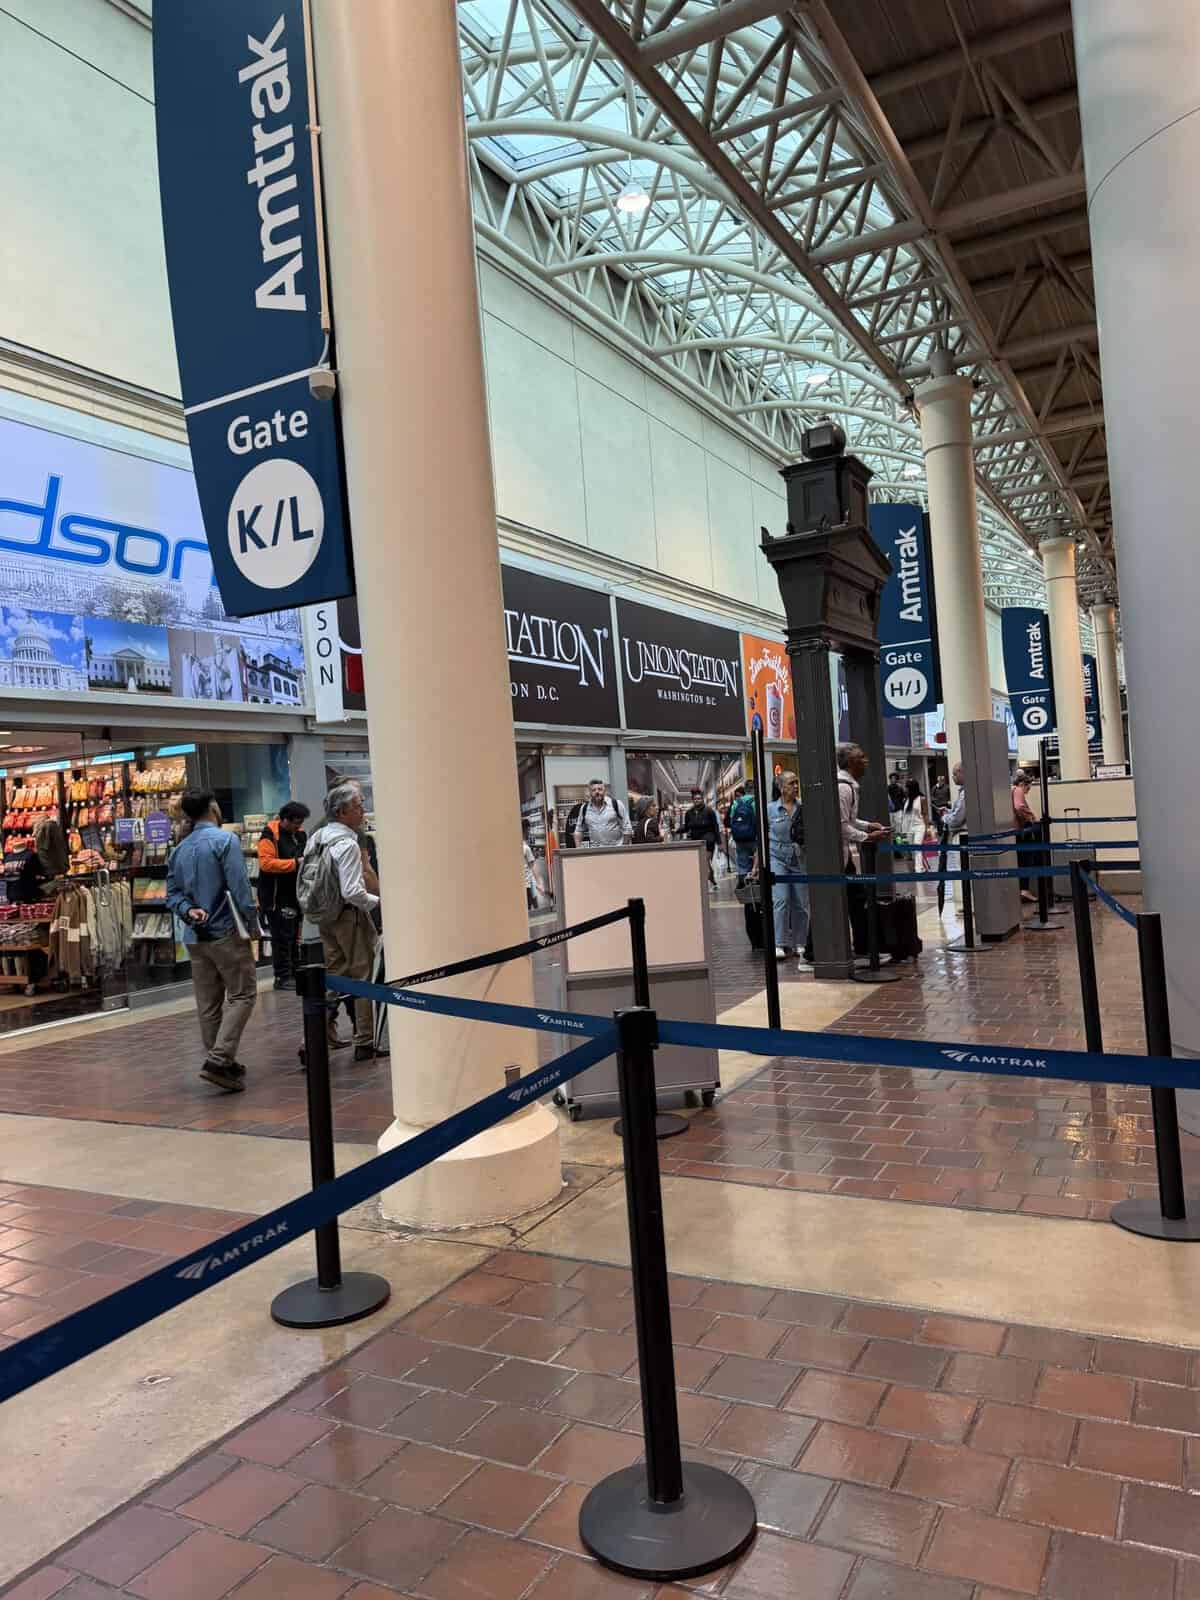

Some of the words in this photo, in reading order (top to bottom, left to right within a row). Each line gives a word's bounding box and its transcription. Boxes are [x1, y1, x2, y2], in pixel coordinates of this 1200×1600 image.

[238, 14, 307, 311] Amtrak
[227, 409, 309, 455] Gate
[237, 495, 314, 554] K/L
[895, 525, 923, 623] Amtrak
[885, 651, 924, 665] Gate
[1026, 621, 1045, 680] Amtrak
[536, 685, 560, 701] D.C.
[656, 689, 704, 704] WASHINGTON
[890, 679, 921, 698] H/J
[1021, 695, 1047, 705] Gate
[1027, 710, 1042, 726] G
[549, 1017, 585, 1029] AMTRAK
[968, 1055, 1047, 1068] AMTRAK
[521, 1069, 561, 1098] AMTRAK
[208, 1220, 289, 1270] AMTRAK
